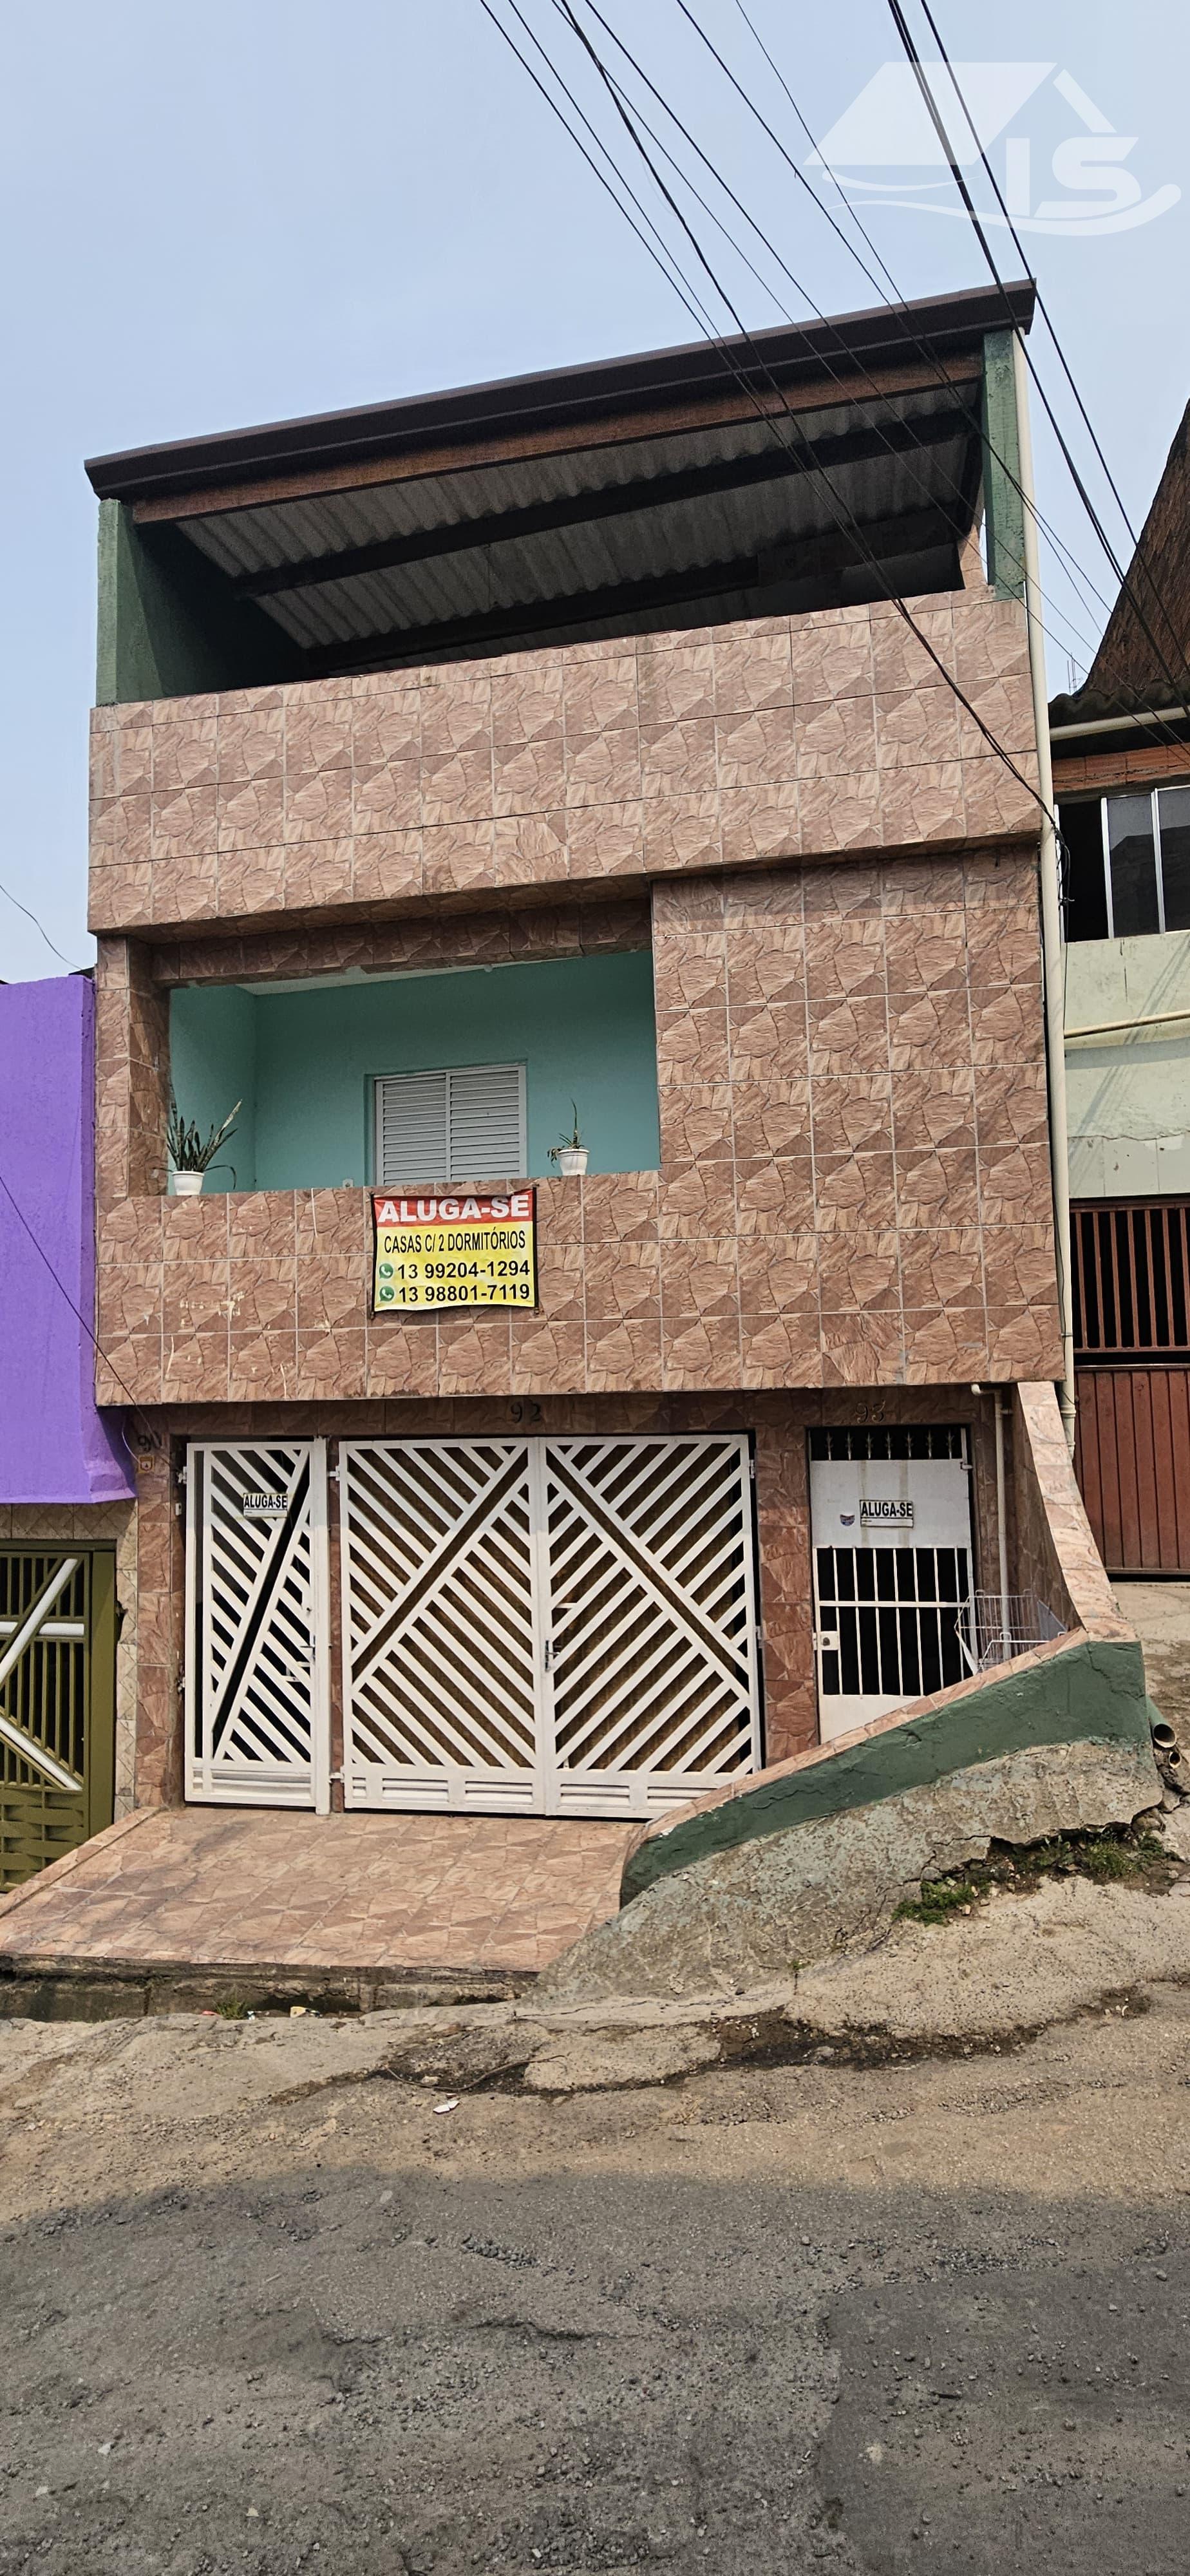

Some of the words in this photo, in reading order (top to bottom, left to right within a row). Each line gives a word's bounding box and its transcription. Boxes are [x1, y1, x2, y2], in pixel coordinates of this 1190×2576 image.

[378, 1195, 529, 1222] ALUGA-SE
[384, 1234, 422, 1253] CASAS
[425, 1233, 436, 1252] C/
[439, 1234, 444, 1251] 2
[448, 1227, 525, 1251] DORMITÓRIOS
[398, 1264, 418, 1279] 13
[425, 1260, 530, 1279] 99204-1294
[399, 1287, 419, 1302] 13
[425, 1283, 530, 1302] 98801-7119
[511, 1402, 541, 1423] 92
[855, 1399, 886, 1424] 93
[245, 1495, 287, 1508] ALUGA-SE
[861, 1502, 912, 1517] ALUGA-SE
